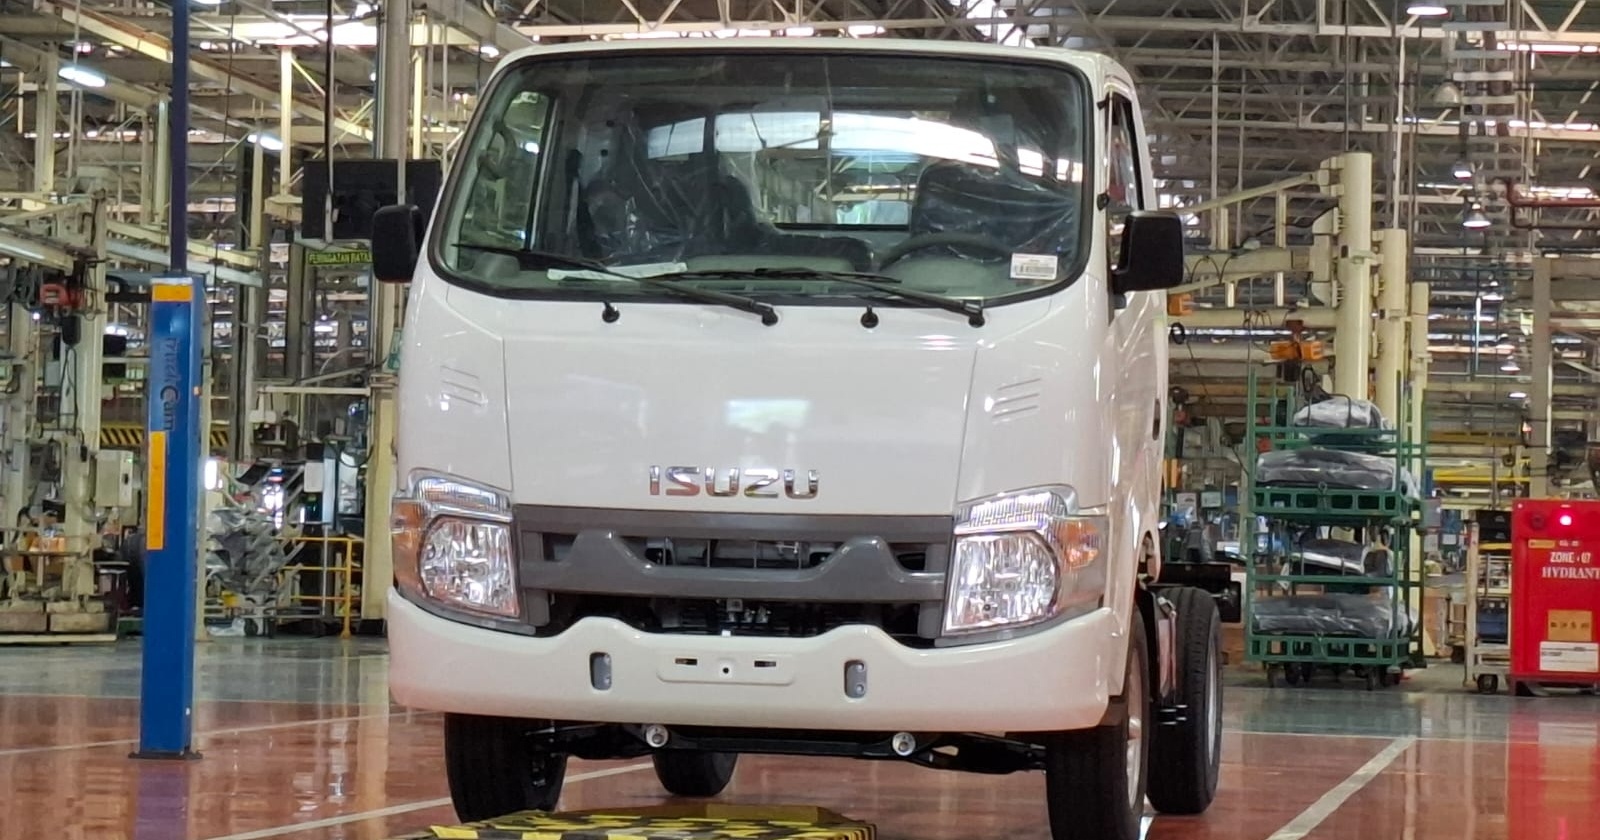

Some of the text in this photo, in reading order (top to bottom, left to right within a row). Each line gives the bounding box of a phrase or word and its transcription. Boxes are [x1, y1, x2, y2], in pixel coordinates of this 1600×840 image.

[650, 465, 820, 499] ISUZU
[1550, 551, 1575, 564] ZONE
[1541, 566, 1600, 579] HYDRANT
